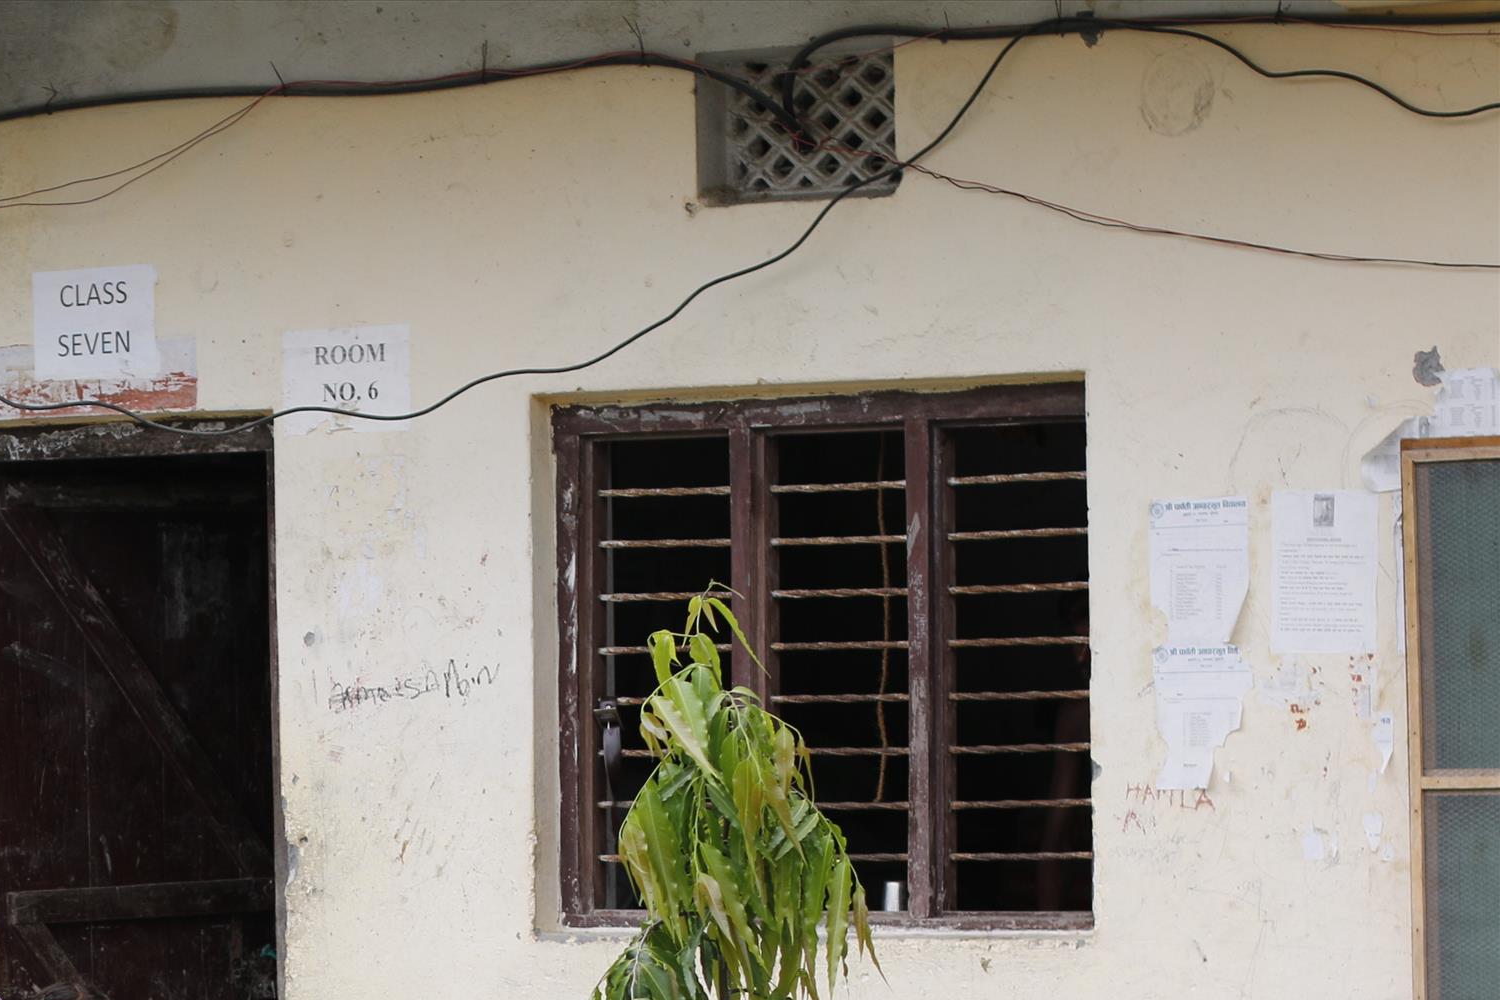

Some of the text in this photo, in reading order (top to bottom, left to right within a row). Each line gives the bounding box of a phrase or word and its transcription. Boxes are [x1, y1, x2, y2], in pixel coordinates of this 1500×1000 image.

[59, 280, 128, 308] CLASS
[57, 330, 131, 358] SEVEN
[314, 343, 386, 366] ROOM
[323, 382, 379, 402] NO. 6
